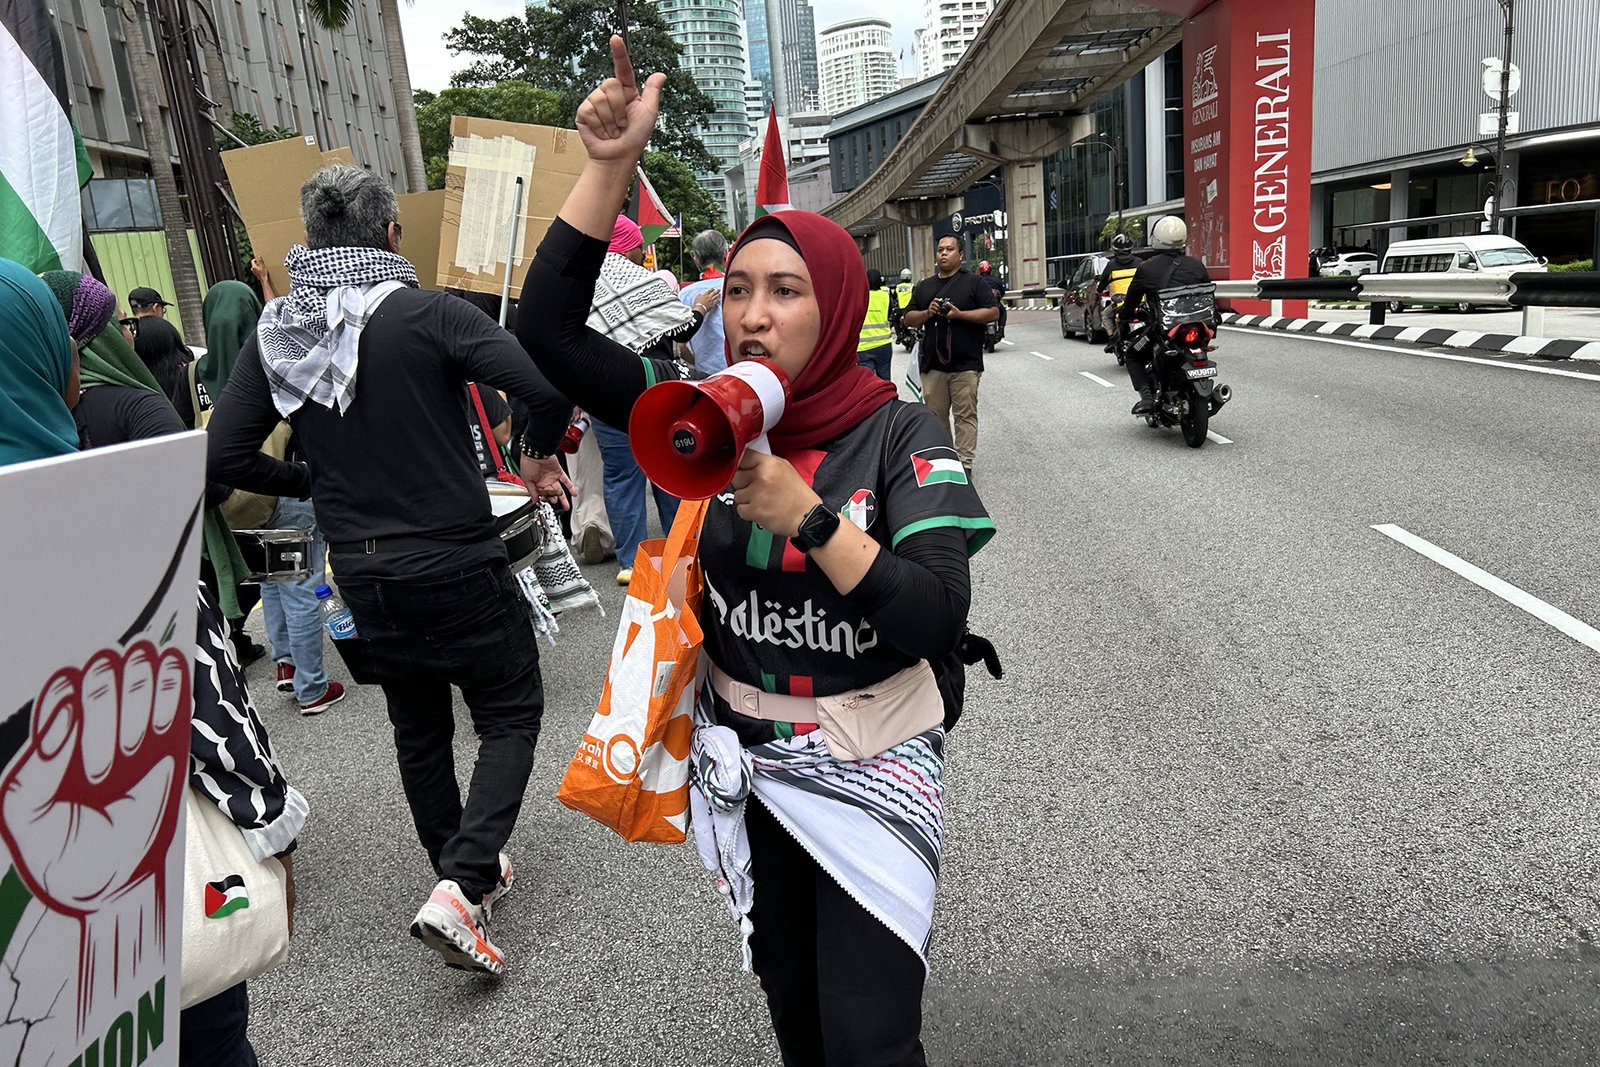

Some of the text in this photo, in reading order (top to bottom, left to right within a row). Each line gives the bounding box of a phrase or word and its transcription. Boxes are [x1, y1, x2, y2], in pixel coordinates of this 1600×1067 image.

[1192, 101, 1218, 126] GENERALI
[1253, 28, 1291, 233] GENERALI
[964, 213, 993, 225] PROTO
